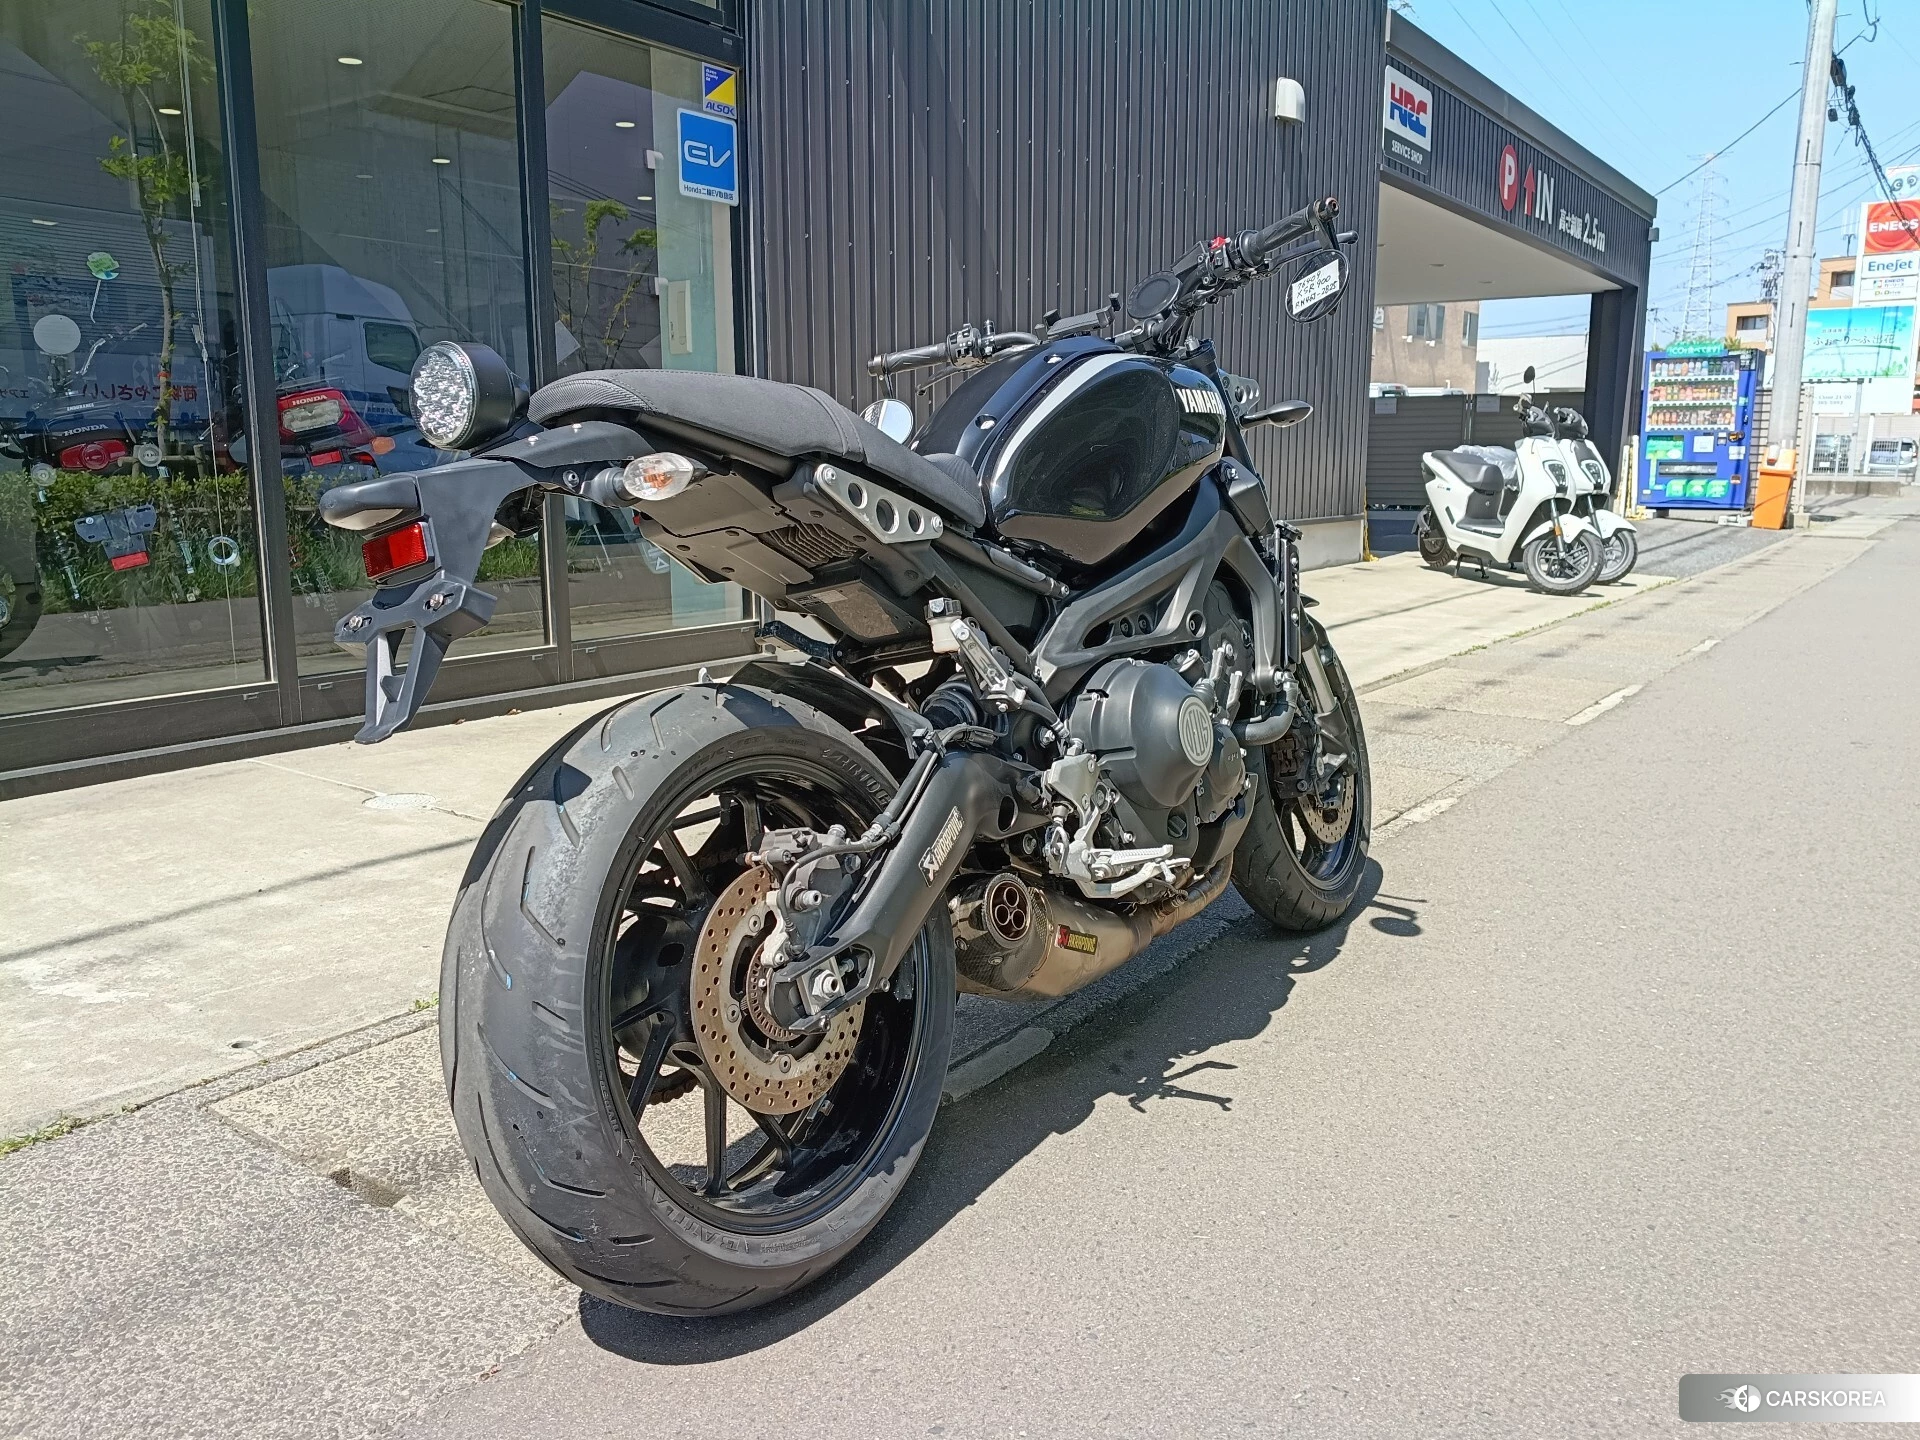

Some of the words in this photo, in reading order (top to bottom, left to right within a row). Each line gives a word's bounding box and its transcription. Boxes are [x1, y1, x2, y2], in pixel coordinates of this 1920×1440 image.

[705, 101, 735, 117] ALSOK
[1389, 81, 1428, 139] HRC
[683, 140, 731, 168] EV
[1391, 140, 1411, 160] SERVICE
[1411, 149, 1423, 165] SHOP
[1503, 153, 1516, 200] P
[1535, 169, 1554, 225] IN
[1583, 212, 1606, 253] 2.5m
[291, 394, 328, 406] HONDA
[1175, 388, 1226, 416] YAMAHA
[63, 423, 109, 437] HONDA
